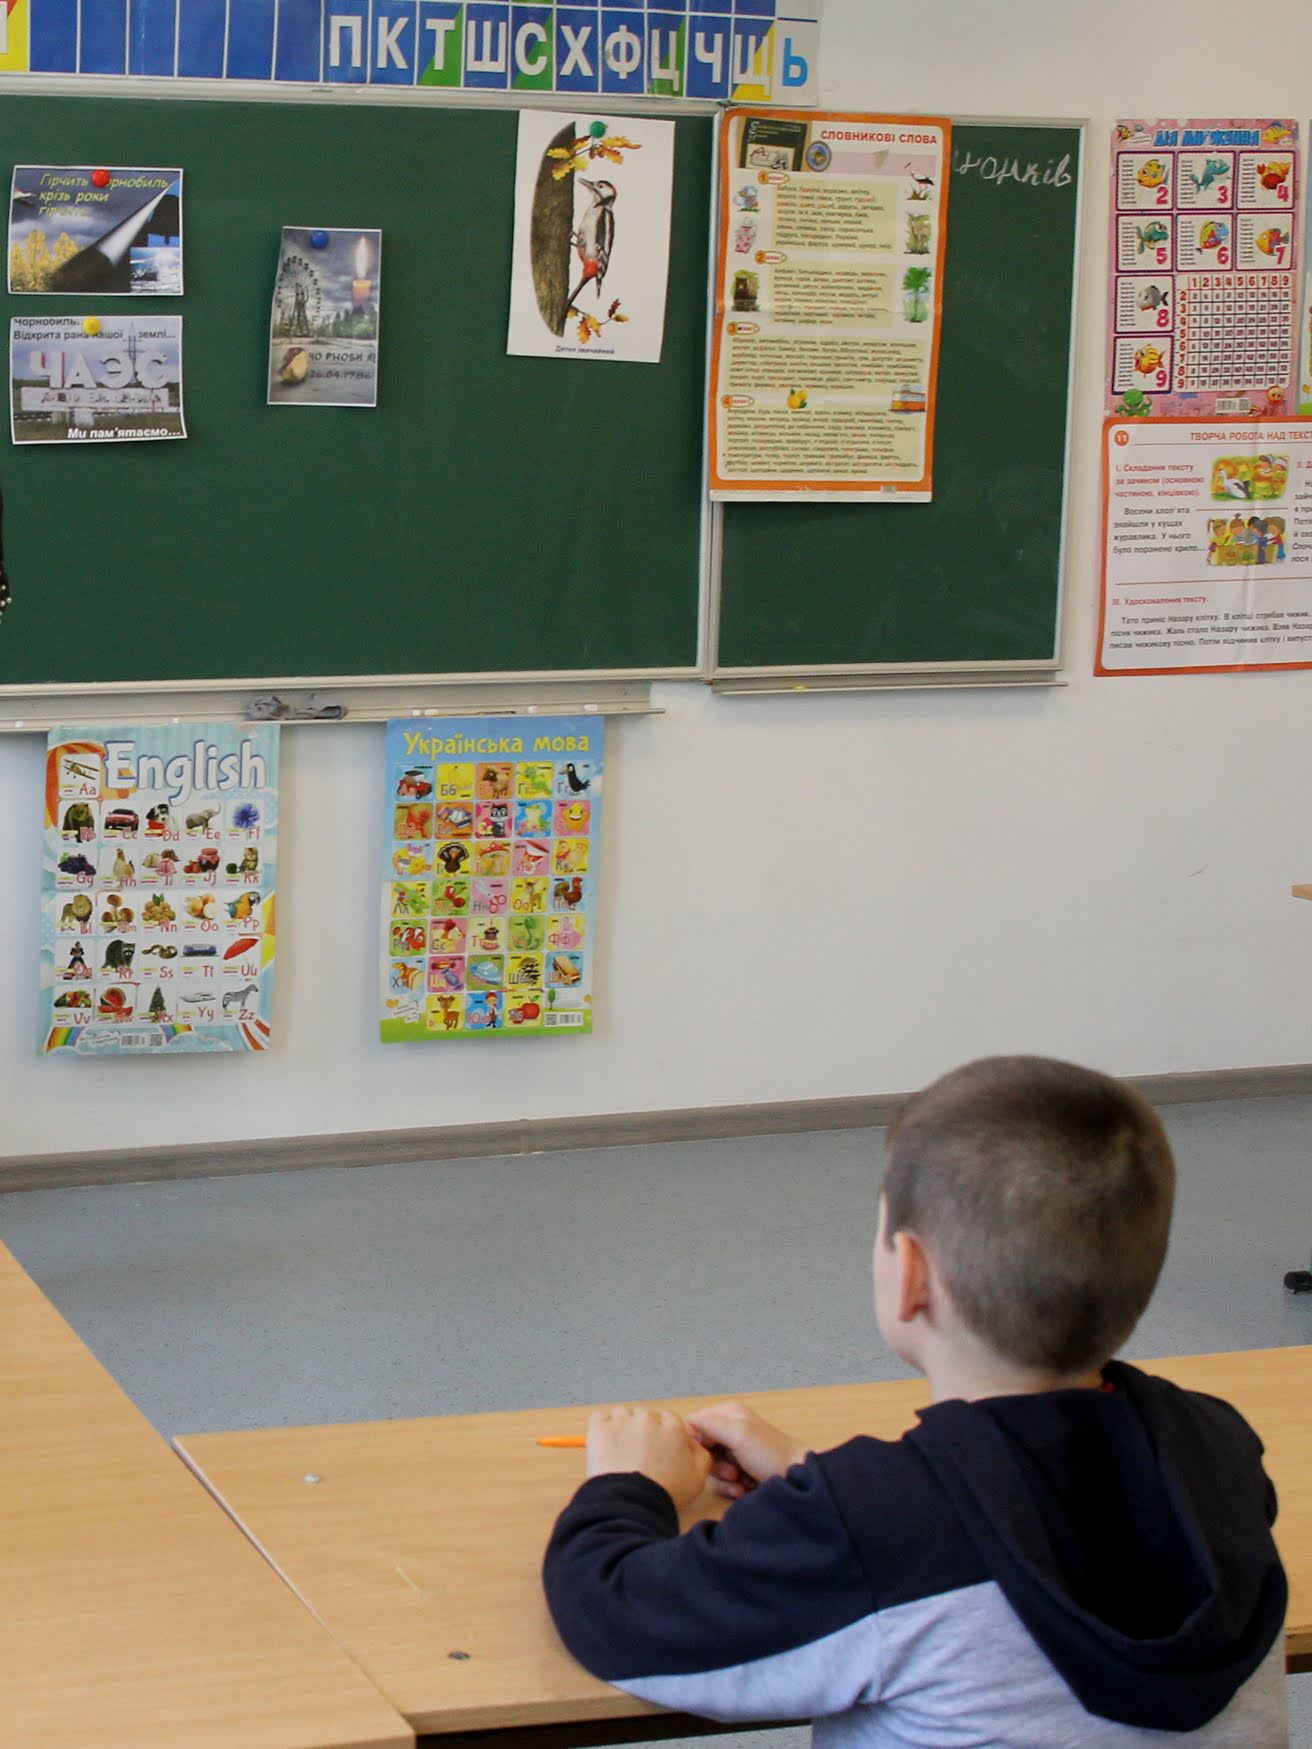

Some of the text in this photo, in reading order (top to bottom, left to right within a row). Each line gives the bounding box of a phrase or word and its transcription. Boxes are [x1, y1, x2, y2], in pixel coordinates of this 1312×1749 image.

[820, 130, 938, 145] СЛОВНИКОВІ СЛОВА
[39, 173, 89, 189] Гірчить
[39, 190, 109, 205] крізь роки
[1156, 185, 1289, 205] 2 3 4
[1156, 246, 1286, 265] 5 6 7
[1156, 309, 1169, 327] 8
[13, 330, 61, 341] Відкрита
[1156, 370, 1168, 387] 9
[67, 428, 87, 439] Ми
[1190, 432, 1226, 441] ТВОРЧА
[1229, 431, 1264, 441] РОБОТА
[1267, 431, 1286, 440] НАД
[403, 731, 590, 761] Українська мова
[104, 738, 266, 807] English
[79, 783, 97, 796] Aa
[440, 783, 457, 797] Бб
[163, 829, 181, 842] Dd
[206, 828, 221, 841] Ee
[76, 871, 94, 888] Gg
[160, 916, 260, 933] Nn Oo Pp
[159, 966, 174, 979] Ss
[73, 1006, 255, 1025] Vv Yy Zz
